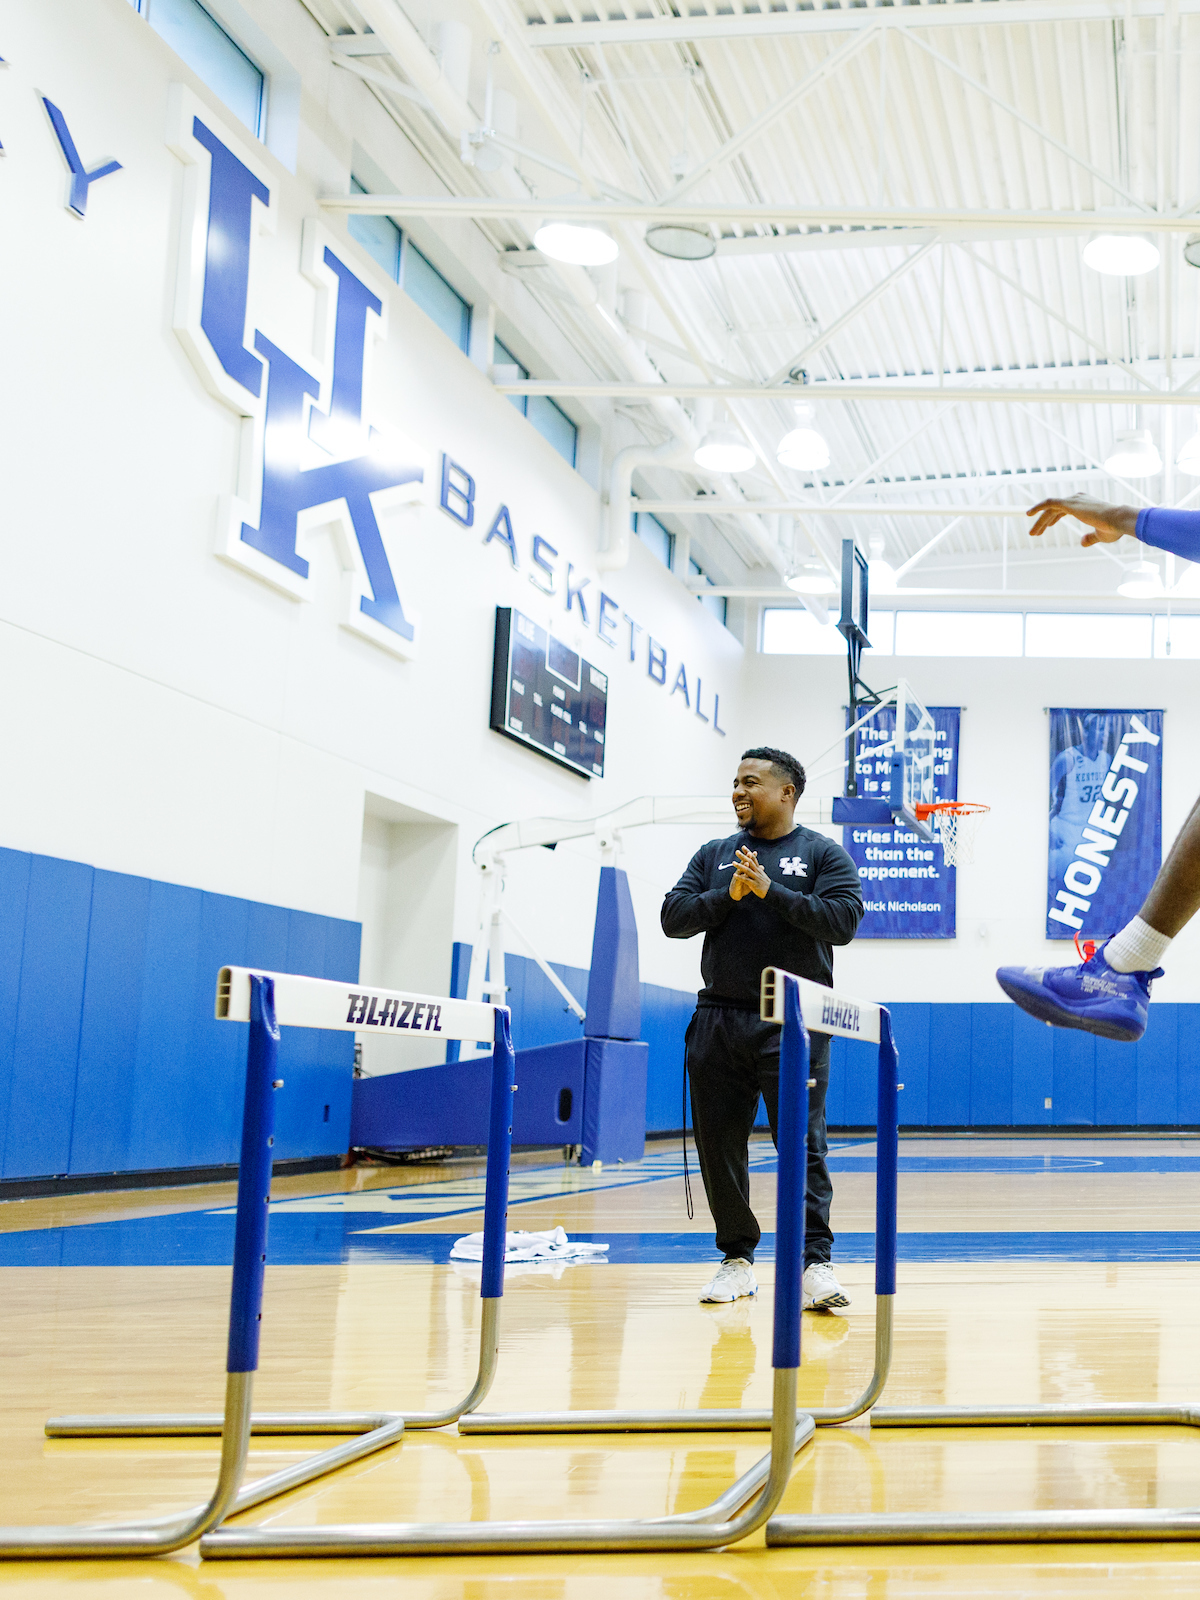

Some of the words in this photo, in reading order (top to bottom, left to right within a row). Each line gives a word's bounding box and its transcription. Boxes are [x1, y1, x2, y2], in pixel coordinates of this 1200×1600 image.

[34, 88, 124, 219] Y
[192, 114, 424, 642] UK
[438, 450, 727, 736] BASKETBALL
[859, 727, 889, 741] The
[856, 761, 873, 775] to
[864, 778, 879, 792] is
[1048, 715, 1160, 930] HONESTY
[853, 829, 892, 844] tries
[865, 846, 904, 861] than
[906, 846, 934, 861] the
[858, 865, 940, 881] opponent.
[862, 901, 886, 912] Nick
[888, 901, 941, 912] Nicholson
[346, 993, 442, 1032] BLAZER
[821, 995, 860, 1032] BLAZER
